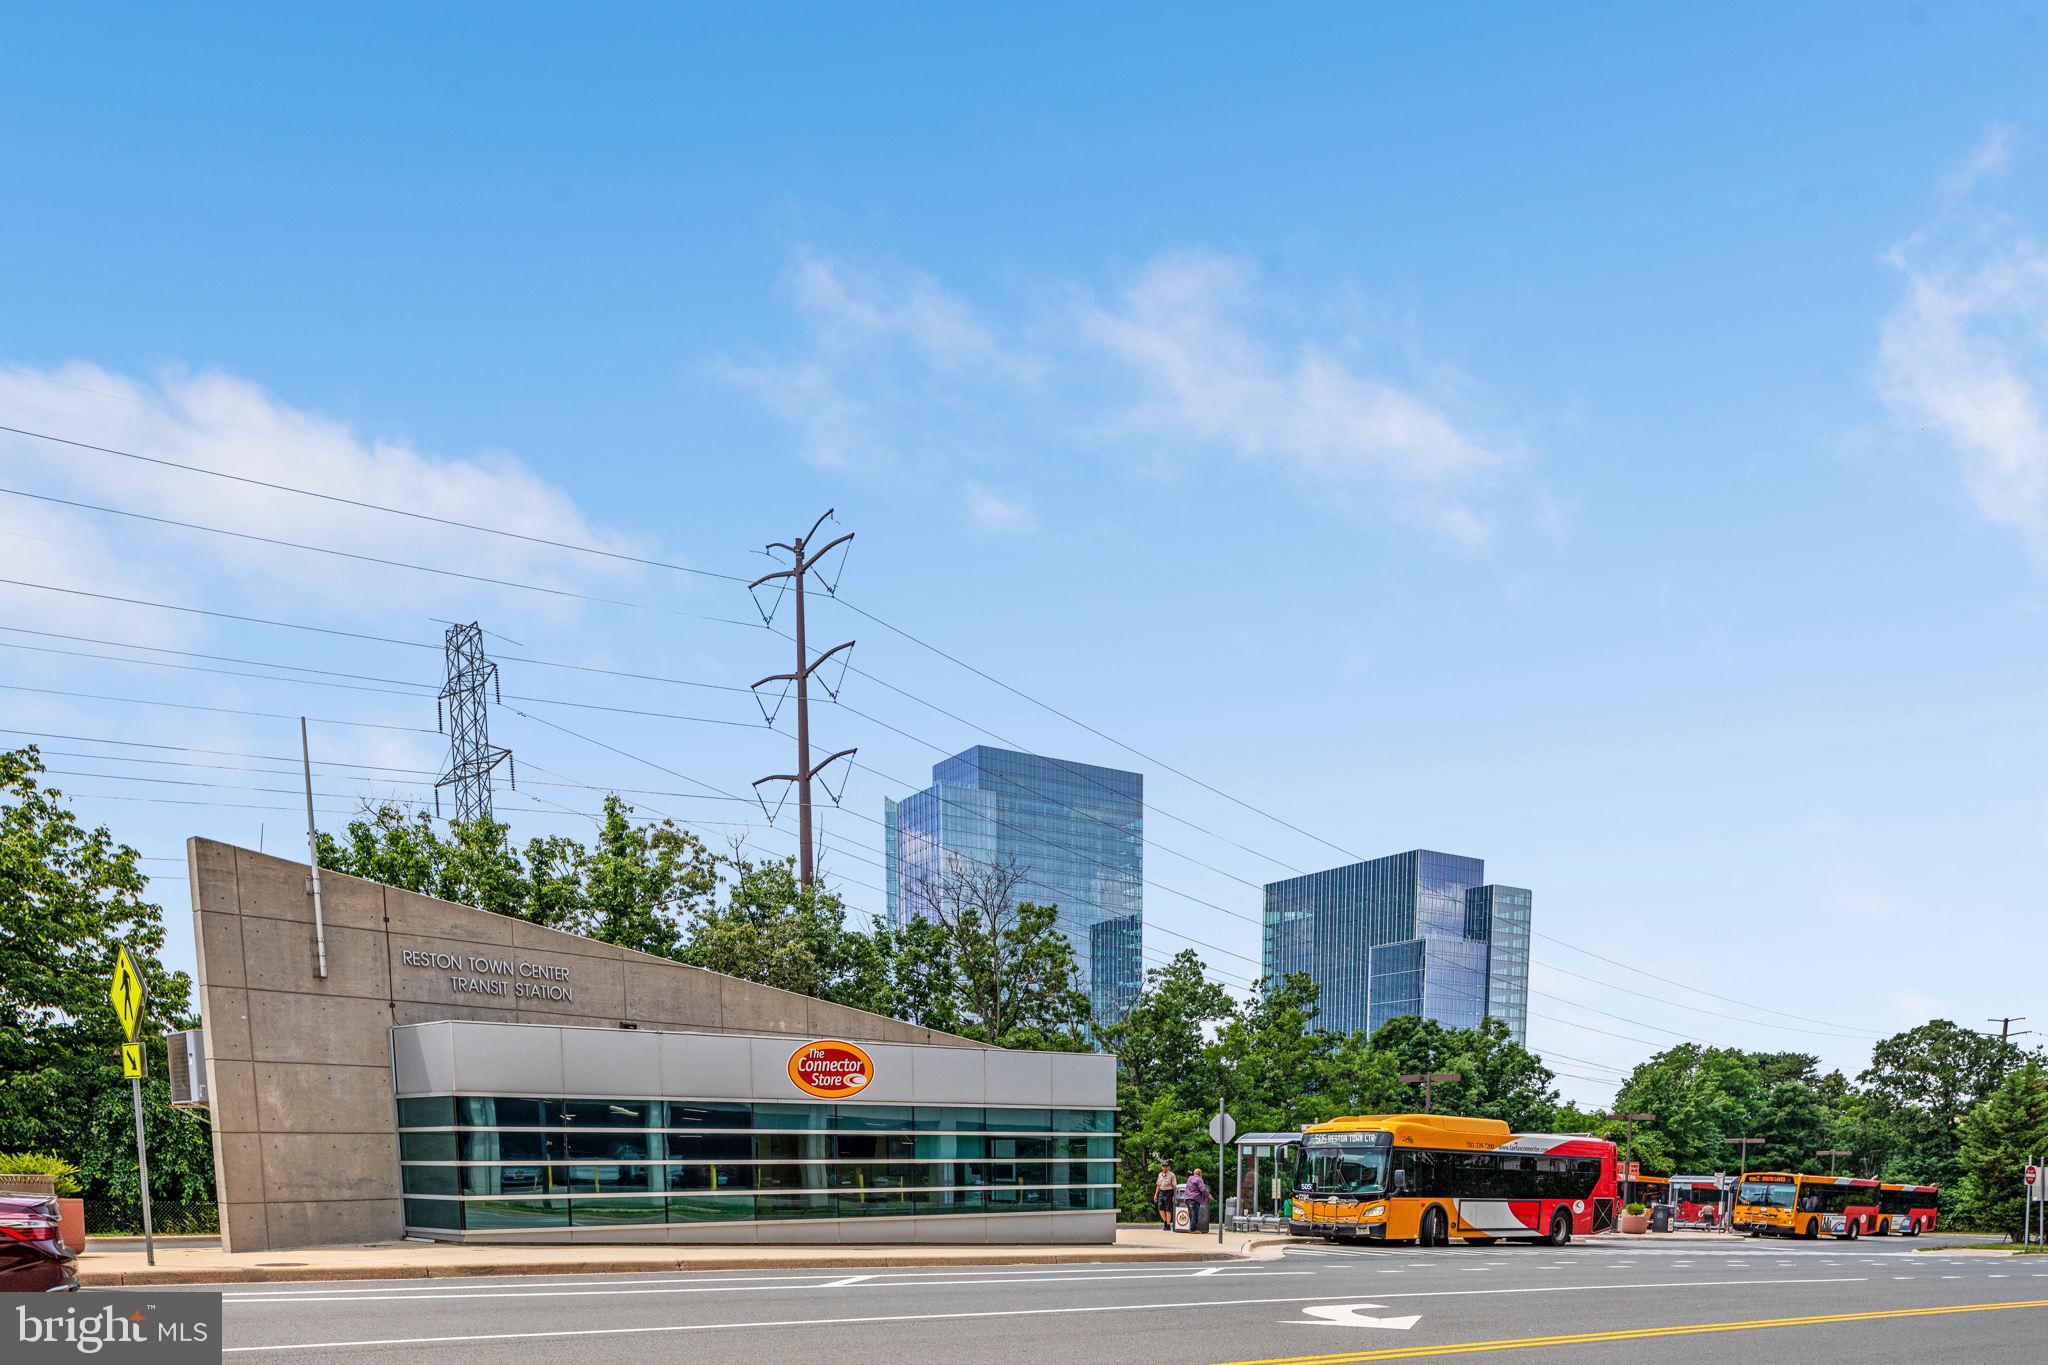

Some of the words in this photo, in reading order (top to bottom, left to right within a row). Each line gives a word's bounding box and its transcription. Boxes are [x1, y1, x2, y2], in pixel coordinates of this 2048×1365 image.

[402, 950, 462, 971] RESTON
[468, 957, 514, 976] TOWN
[519, 963, 570, 982] CENTER
[451, 977, 508, 997] TRANSIT
[515, 982, 573, 1001] STATION
[808, 1048, 825, 1059] The
[798, 1057, 863, 1072] Connector
[811, 1073, 842, 1086] Store
